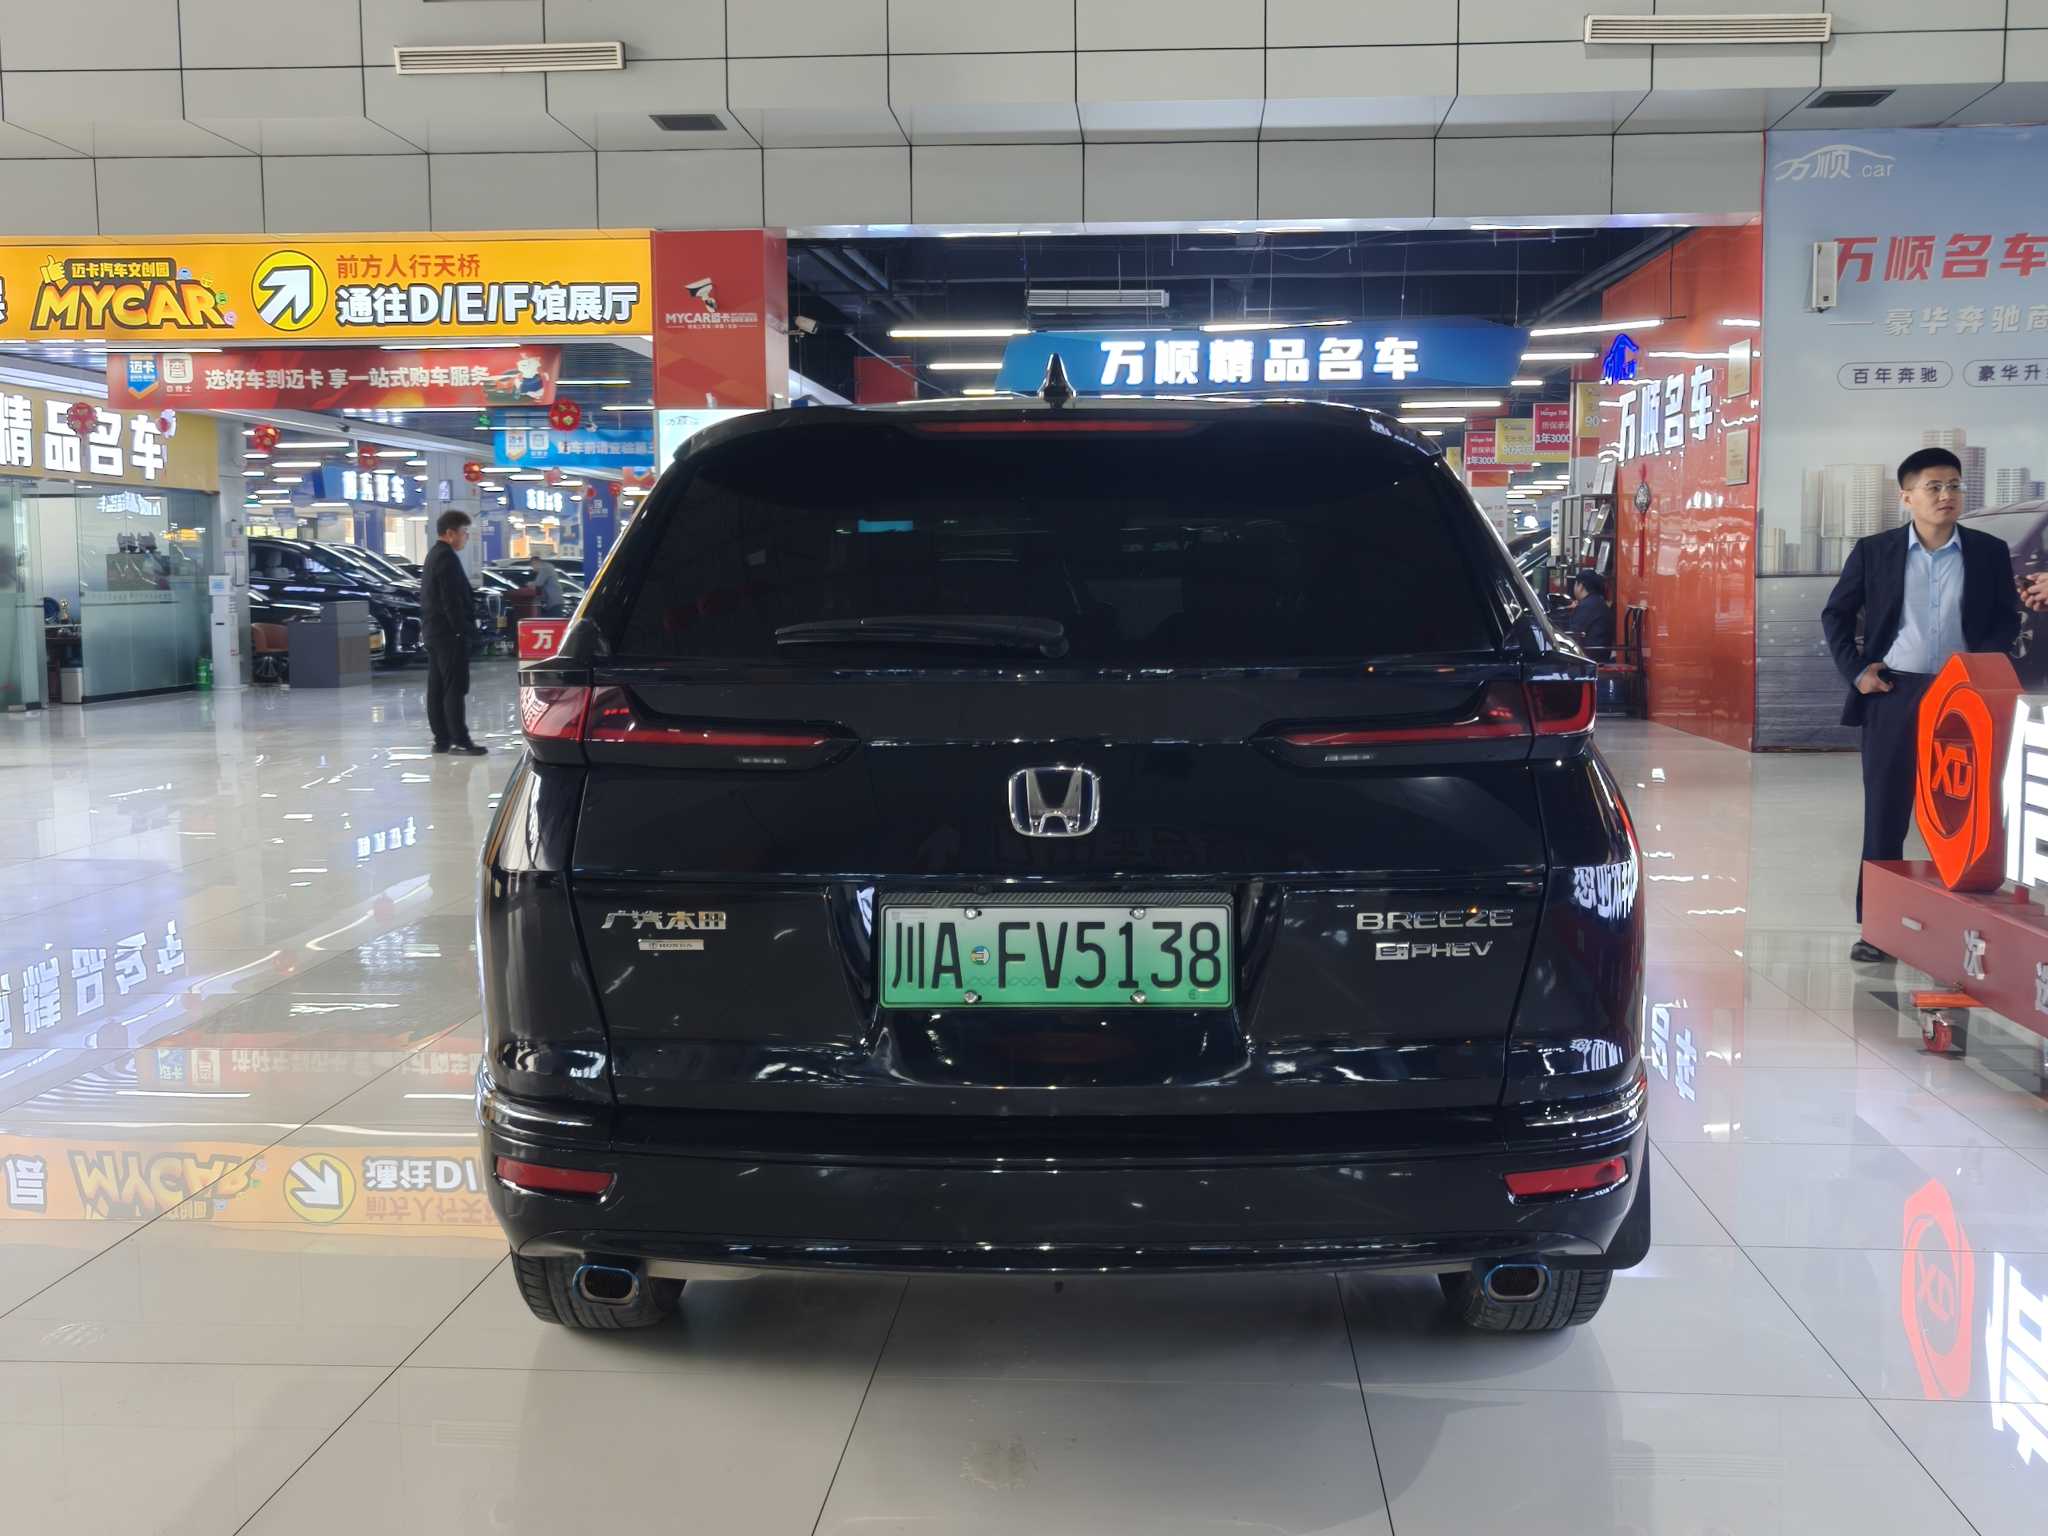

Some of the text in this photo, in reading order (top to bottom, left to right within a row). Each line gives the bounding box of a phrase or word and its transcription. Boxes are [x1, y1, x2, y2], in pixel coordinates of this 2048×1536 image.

[1862, 160, 1895, 178] car
[336, 253, 481, 279] 前方人行天桥
[1830, 231, 2048, 284] 万顺名车
[32, 281, 233, 330] MYCAR
[336, 281, 640, 326] 通往D/E/F馆展厅
[1100, 336, 1420, 386] 万顺精品名车
[1977, 363, 2048, 383] 豪华升
[204, 365, 489, 391] 选好车到迈卡 享一站式购车服务
[1852, 366, 1938, 385] 百年奔驰
[1618, 364, 1714, 464] 万顺名车
[532, 630, 555, 650] 万
[1356, 908, 1514, 931] BREEZE
